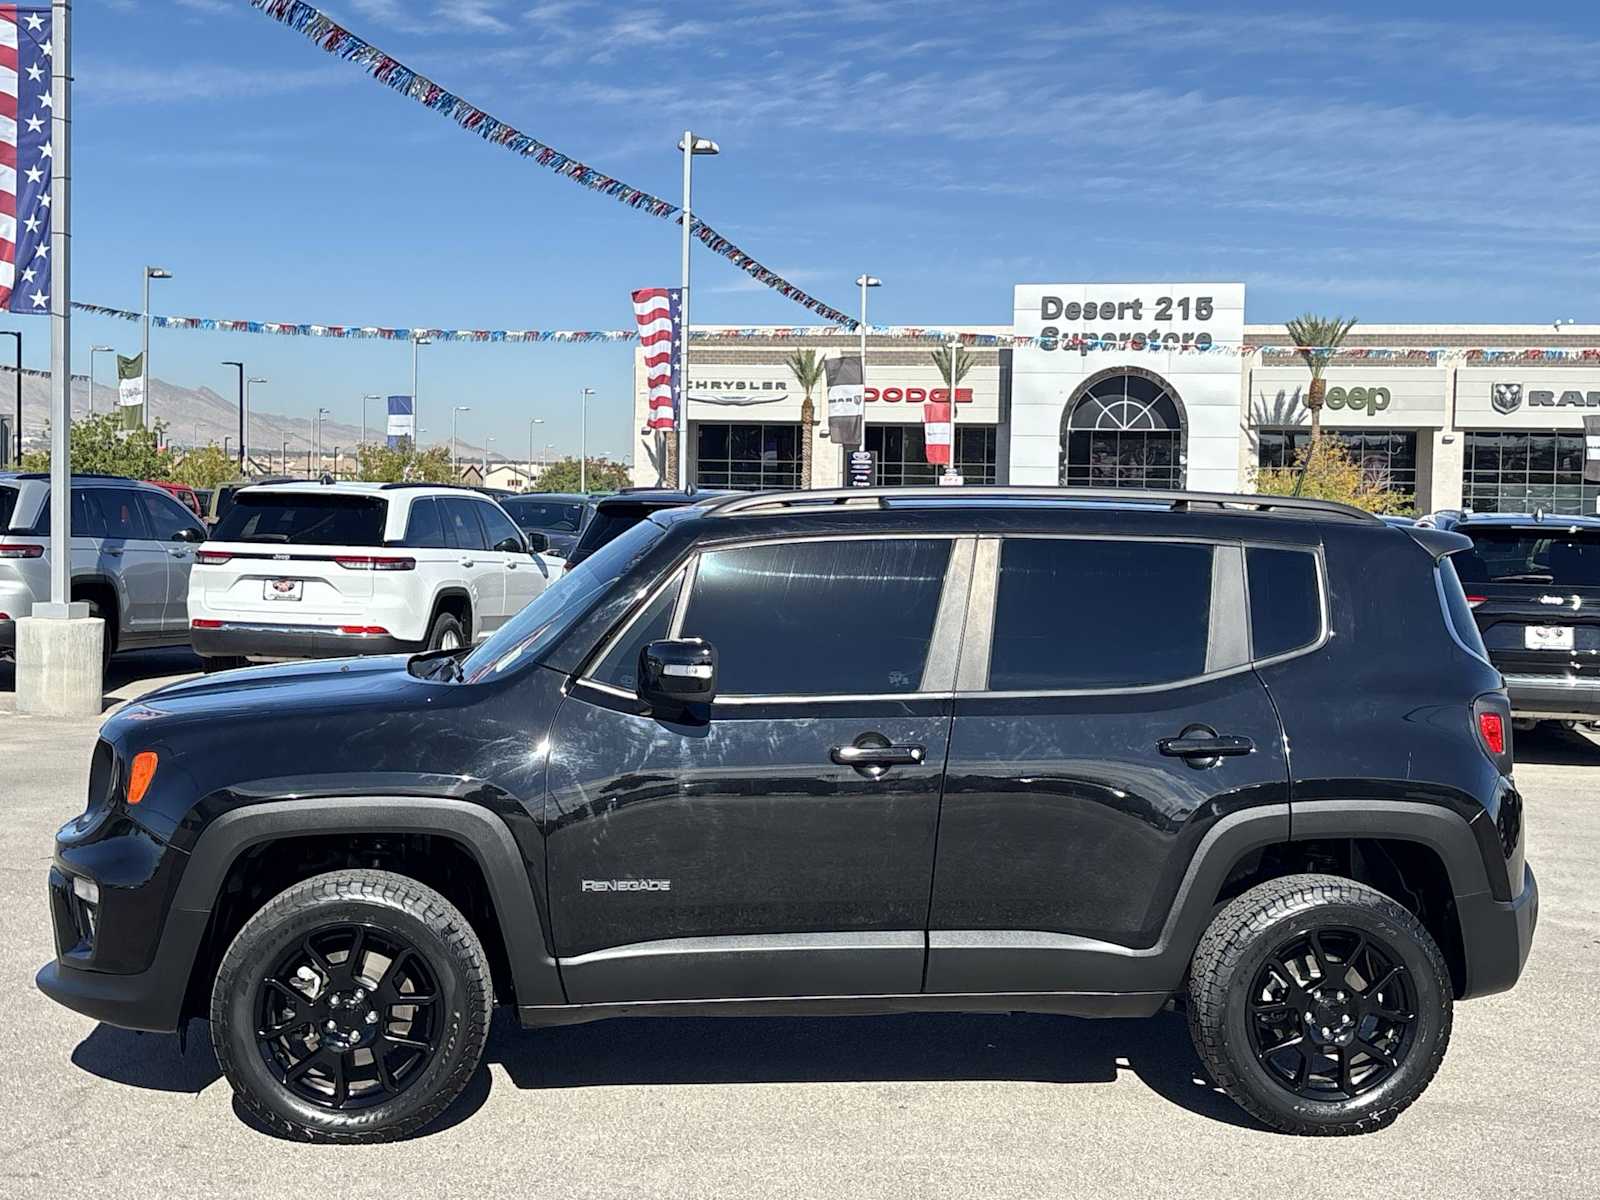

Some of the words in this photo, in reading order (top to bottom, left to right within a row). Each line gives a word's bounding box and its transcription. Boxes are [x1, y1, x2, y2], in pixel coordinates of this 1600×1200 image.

[1041, 296, 1143, 321] Desert
[1154, 296, 1214, 321] 215
[272, 553, 291, 561] Jeep
[582, 879, 671, 892] RENEGADE
